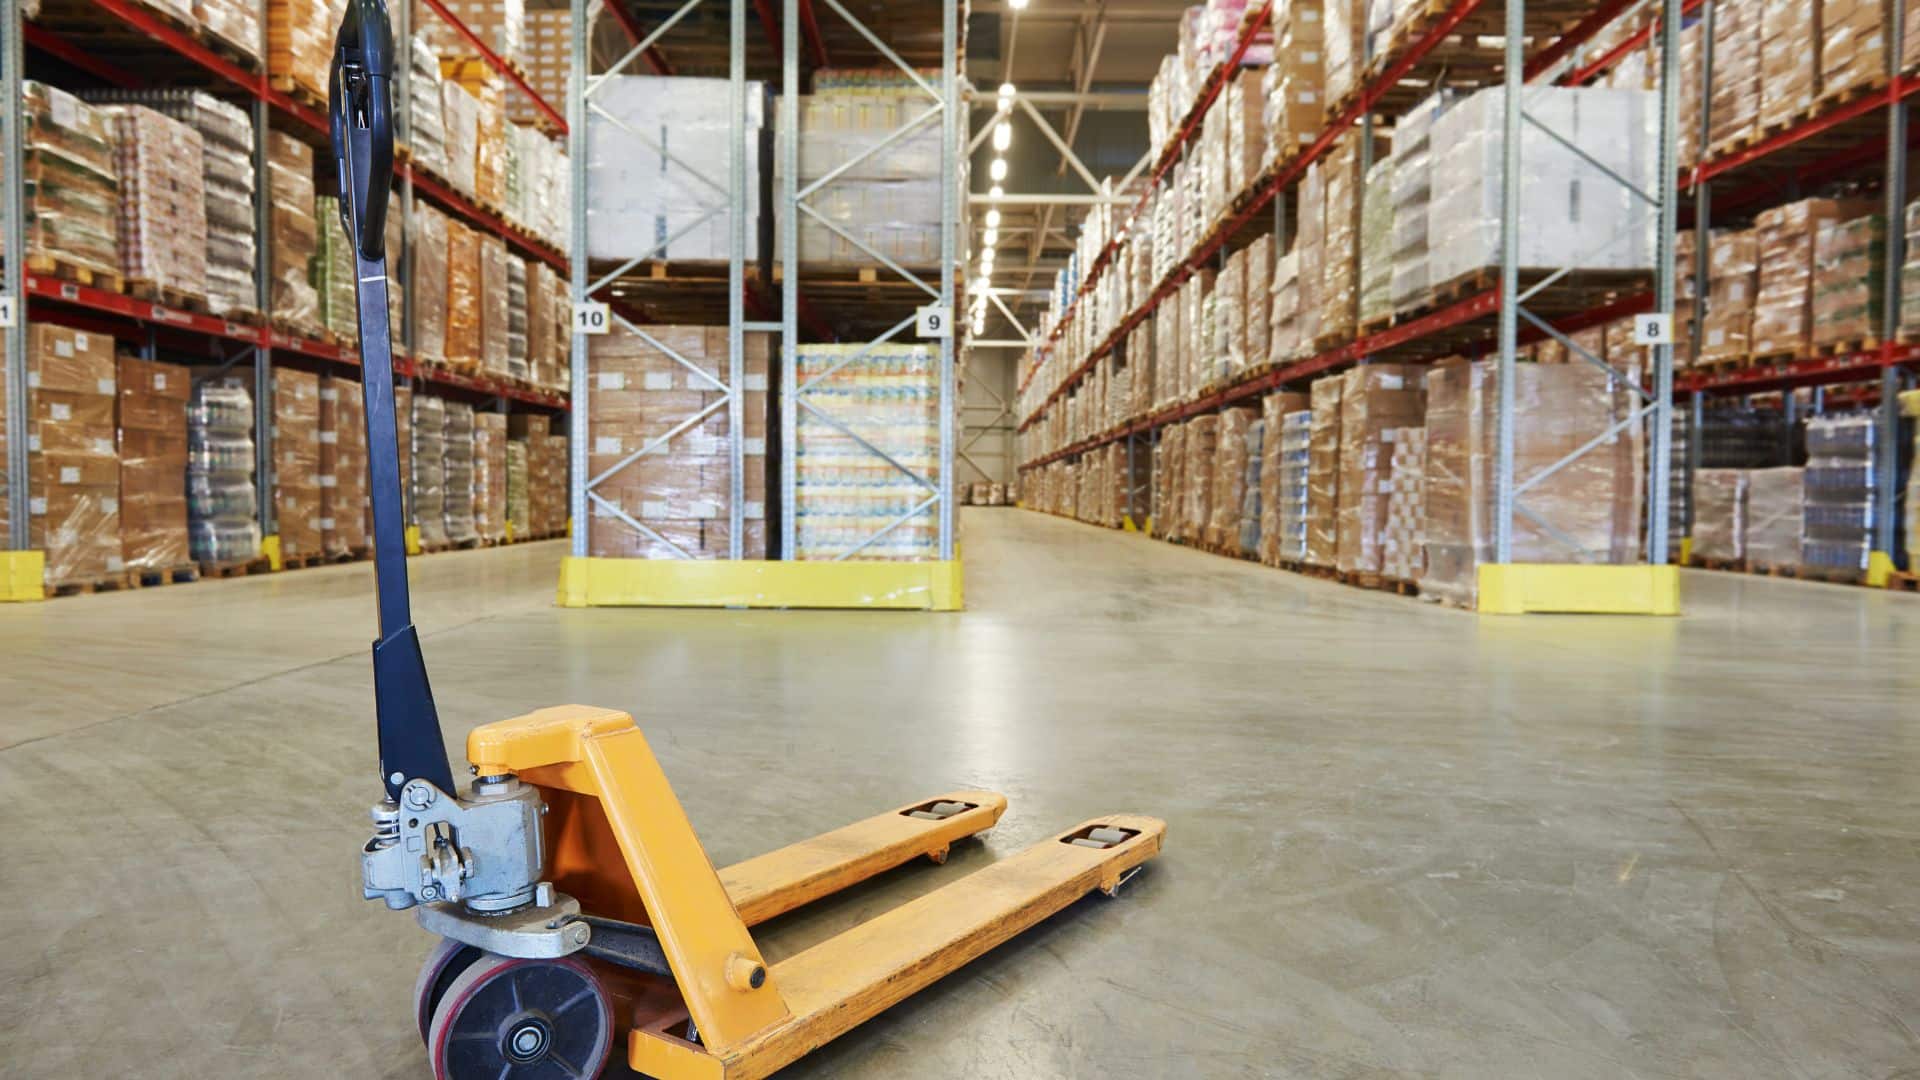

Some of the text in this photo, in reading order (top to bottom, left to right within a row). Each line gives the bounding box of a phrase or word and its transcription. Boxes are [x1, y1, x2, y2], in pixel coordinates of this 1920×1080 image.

[578, 311, 603, 327] 10
[928, 314, 941, 330] 9
[1647, 321, 1659, 337] 8
